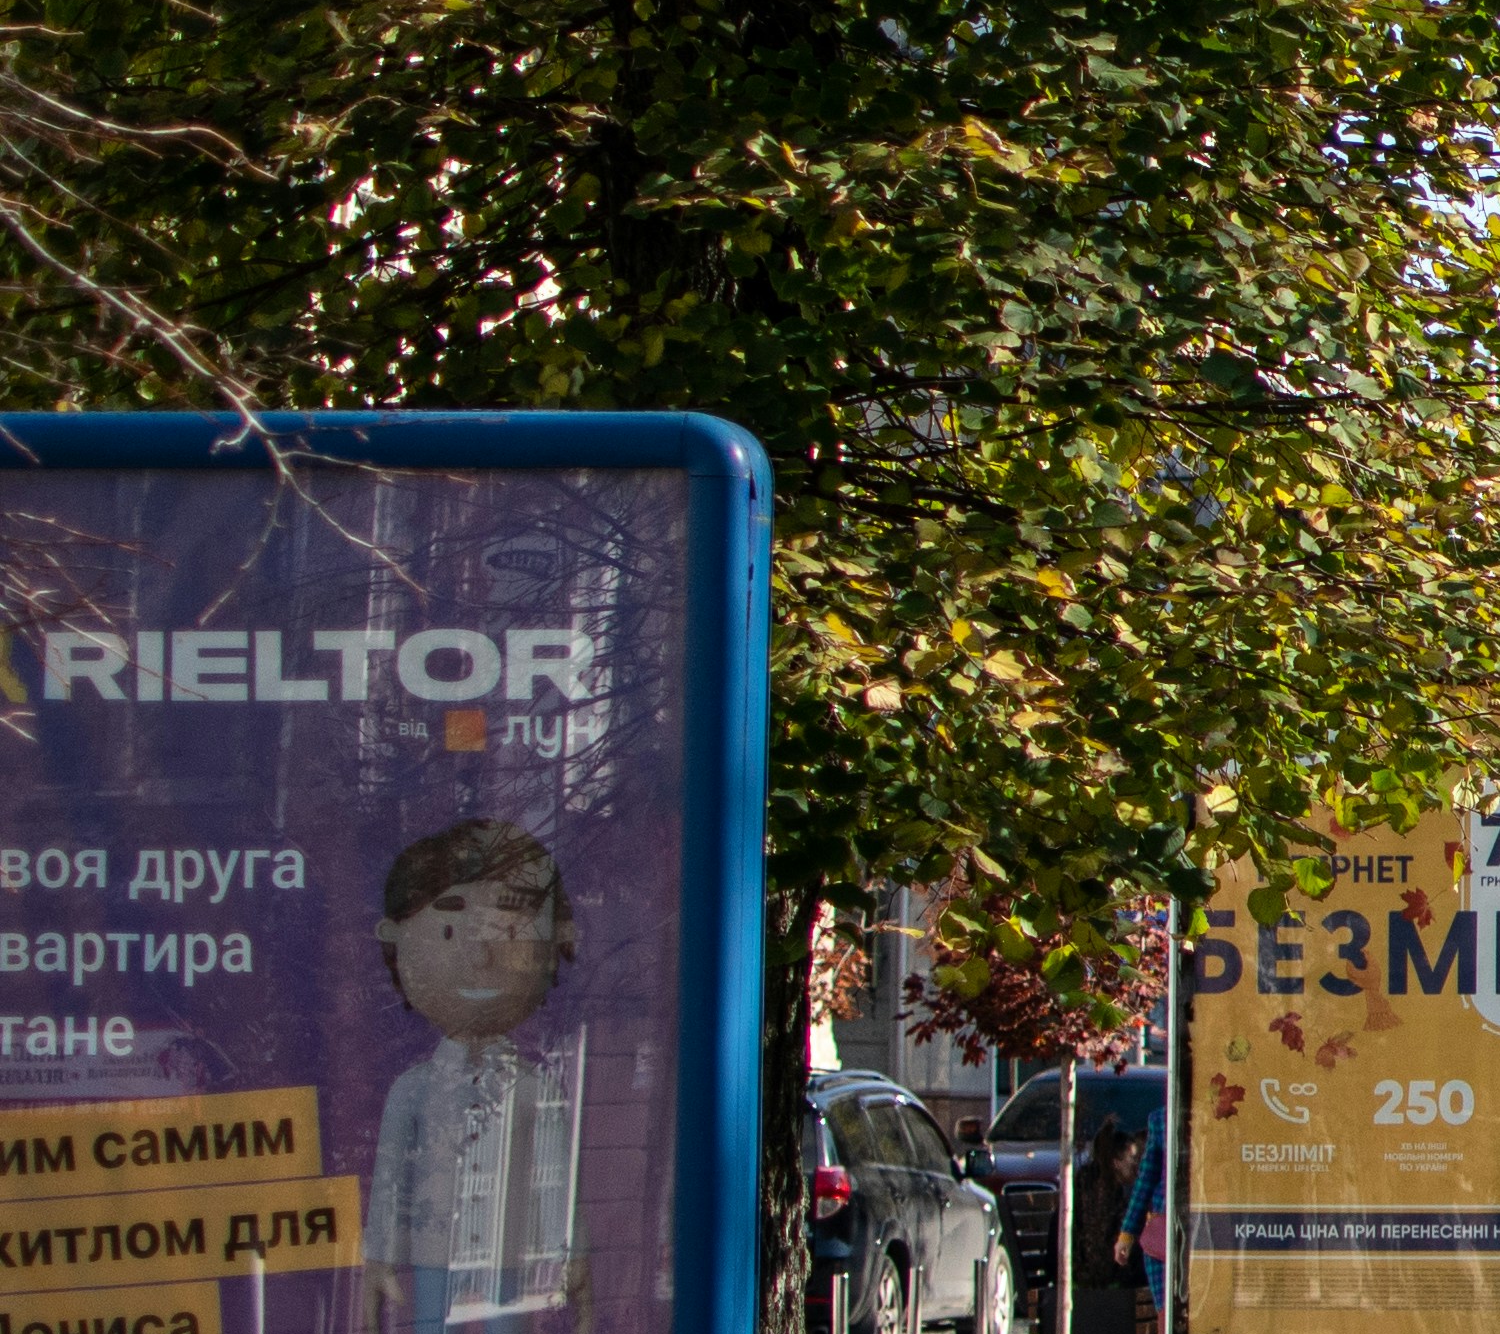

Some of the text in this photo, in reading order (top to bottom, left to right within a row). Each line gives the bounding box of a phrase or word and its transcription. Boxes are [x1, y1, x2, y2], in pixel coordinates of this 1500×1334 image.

[44, 628, 609, 702] RIELTOR
[398, 718, 430, 739] від
[128, 848, 306, 904] друга
[1373, 1079, 1475, 1125] 250
[93, 1117, 295, 1169] самим
[1241, 1143, 1337, 1164] БЕЗЛІМІТ
[223, 1207, 338, 1262] для
[1234, 1223, 1296, 1242] КРАЩА
[1300, 1223, 1340, 1242] ЦІНА
[1344, 1223, 1376, 1240] ПРИ
[1381, 1223, 1489, 1240] ПЕРЕНЕСЕННІ
